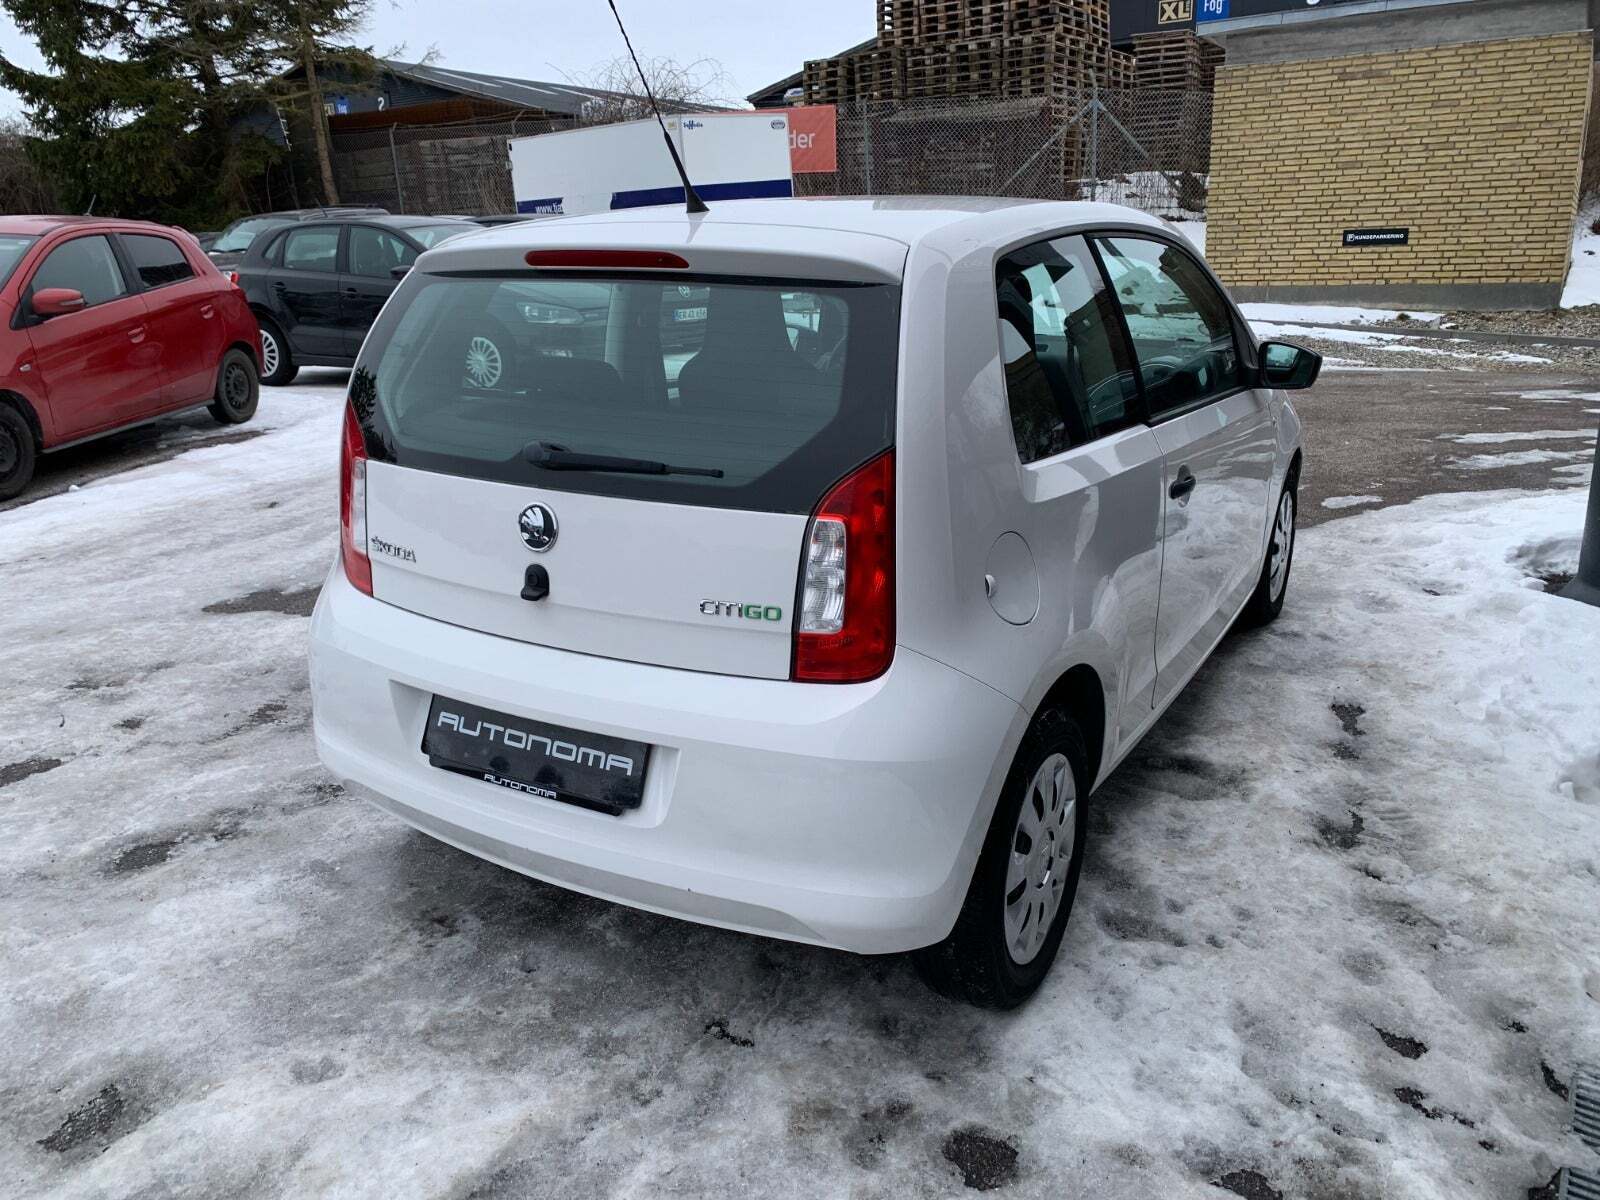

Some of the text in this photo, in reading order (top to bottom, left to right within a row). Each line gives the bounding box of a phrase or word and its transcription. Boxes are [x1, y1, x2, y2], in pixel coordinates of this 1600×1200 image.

[1160, 1, 1190, 21] XL
[1203, 0, 1223, 14] Fog
[700, 599, 782, 621] CITIGO
[437, 711, 634, 776] AUTONOMA
[484, 773, 557, 799] AUTONOMA
